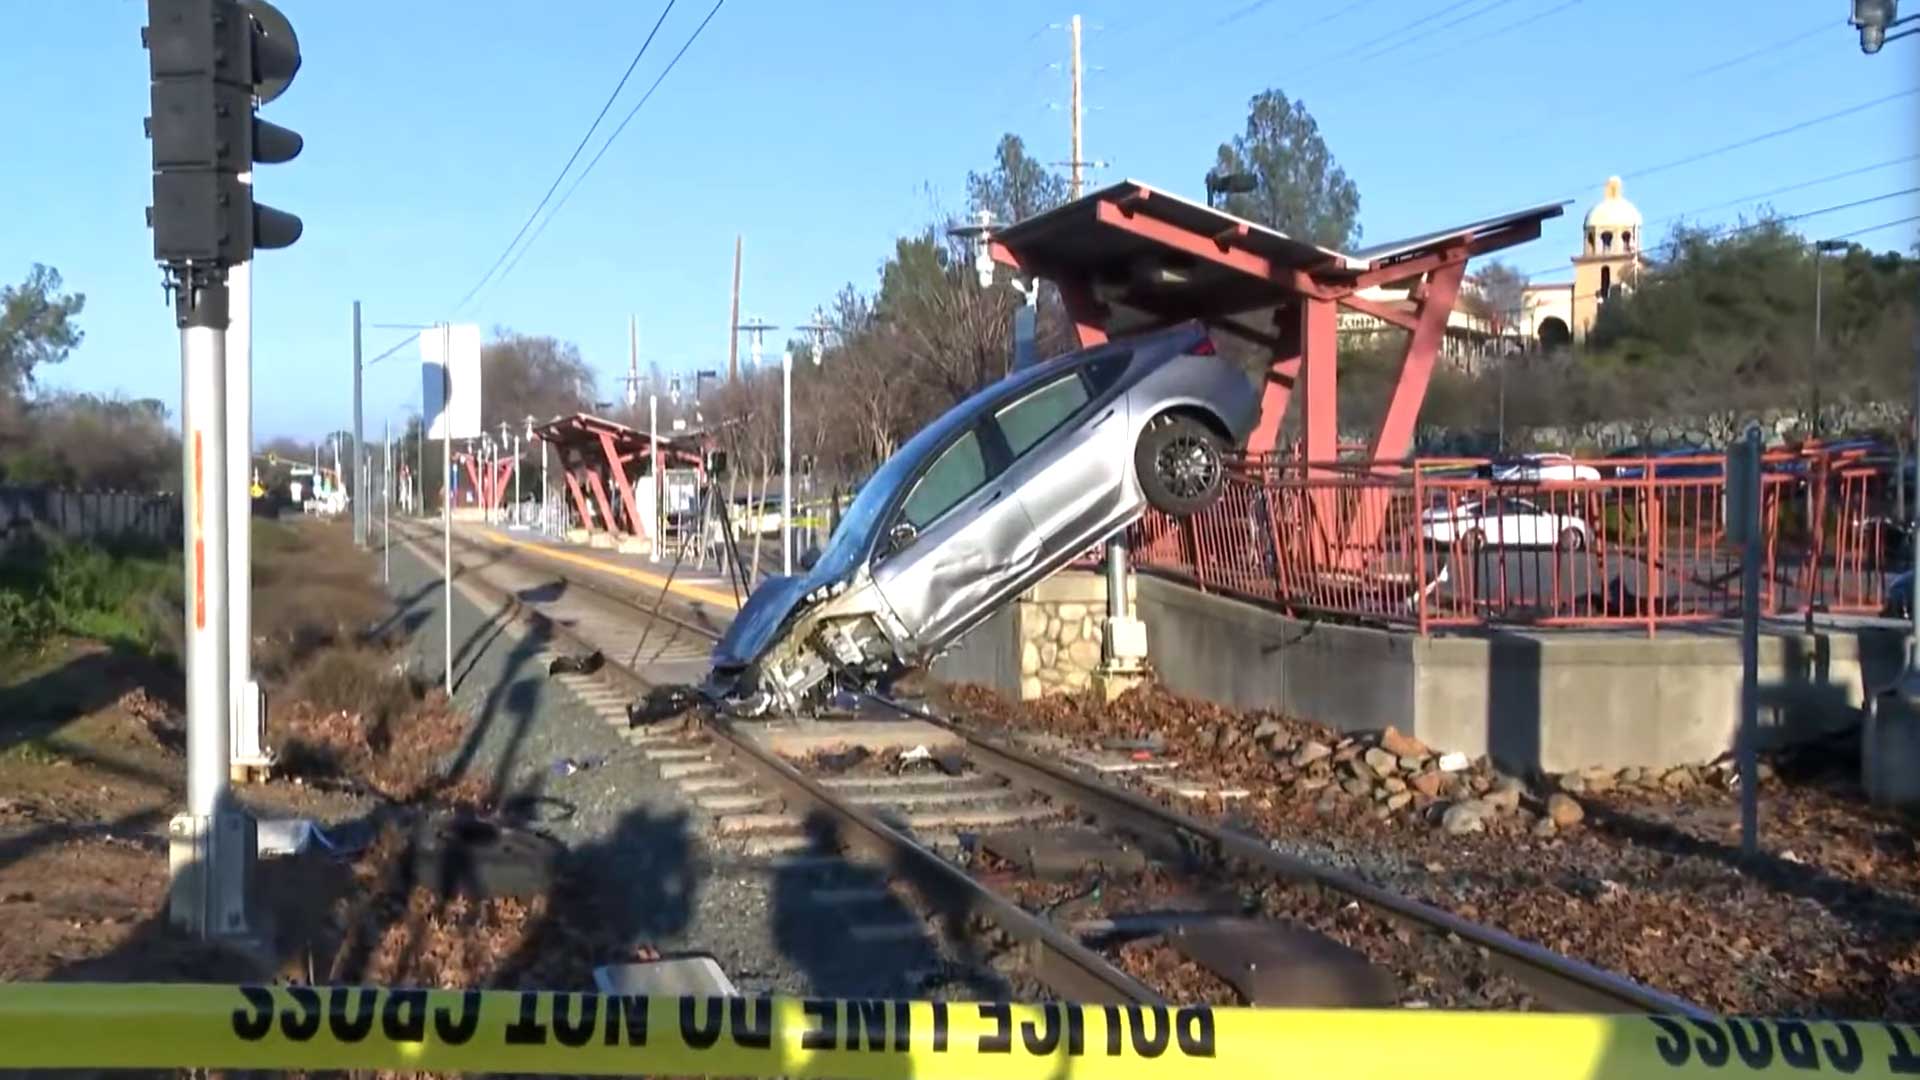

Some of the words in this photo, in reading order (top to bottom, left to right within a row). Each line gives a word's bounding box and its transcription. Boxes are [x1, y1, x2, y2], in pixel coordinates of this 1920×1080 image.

[232, 986, 483, 1044] CROSS
[505, 991, 649, 1047] NOT
[679, 996, 771, 1050] DO
[801, 1000, 948, 1053] LINE
[978, 1002, 1216, 1058] POLICE
[1648, 1016, 1863, 1074] CROSS
